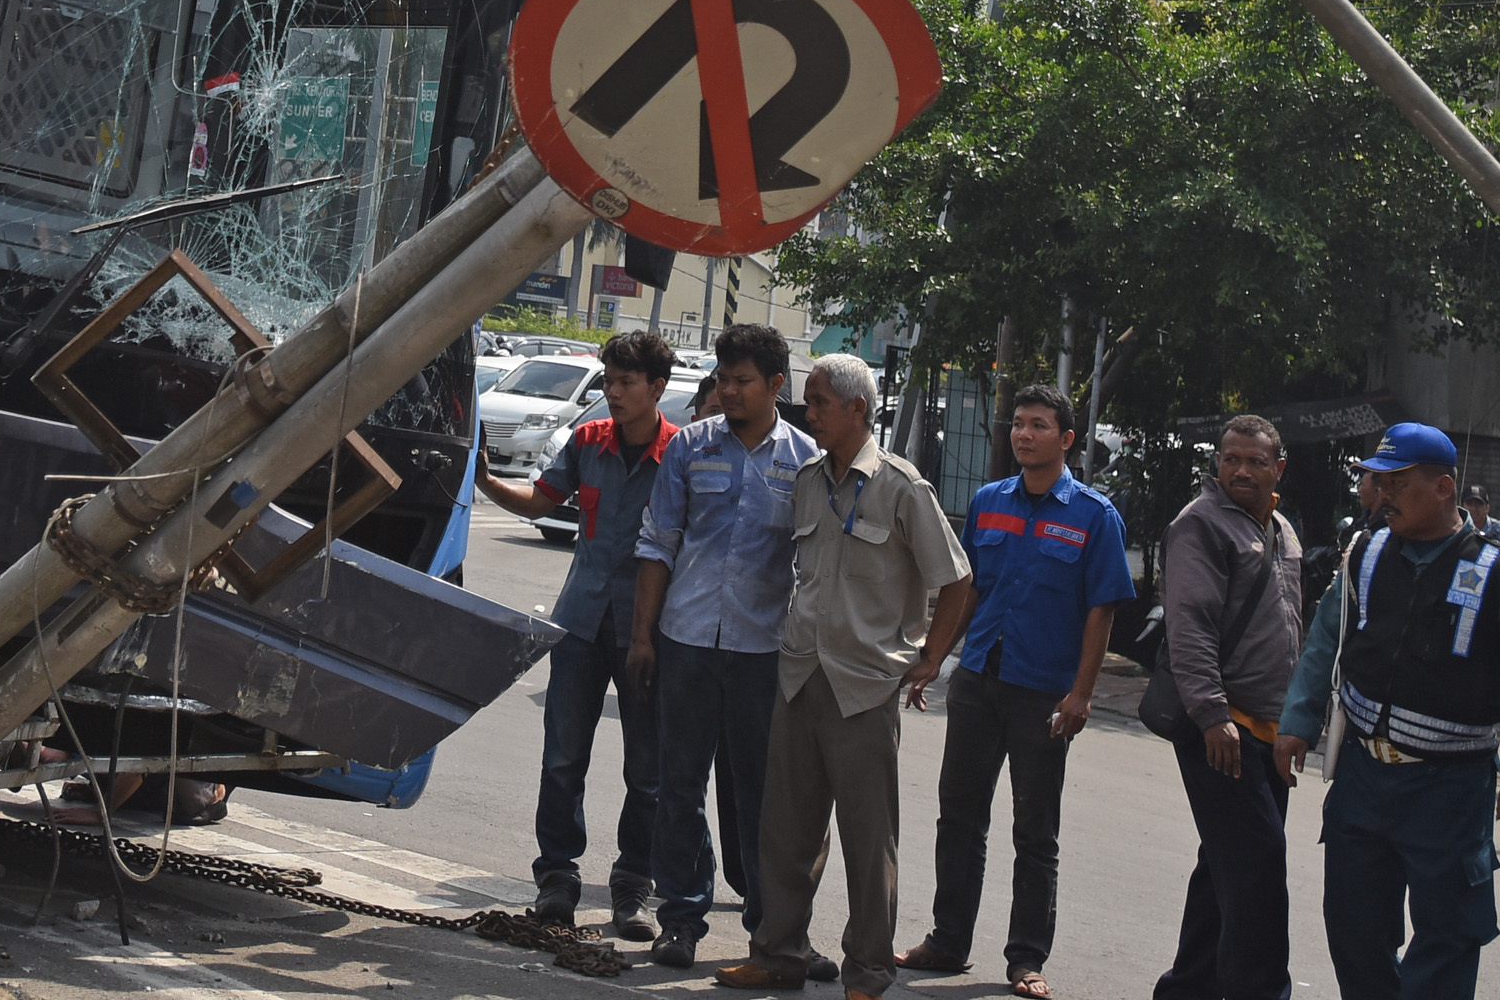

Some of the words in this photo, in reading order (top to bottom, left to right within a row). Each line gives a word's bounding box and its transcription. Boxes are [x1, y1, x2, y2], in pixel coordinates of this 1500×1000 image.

[596, 200, 615, 215] DKI
[599, 190, 628, 210] DISHUB
[605, 281, 634, 292] victoria
